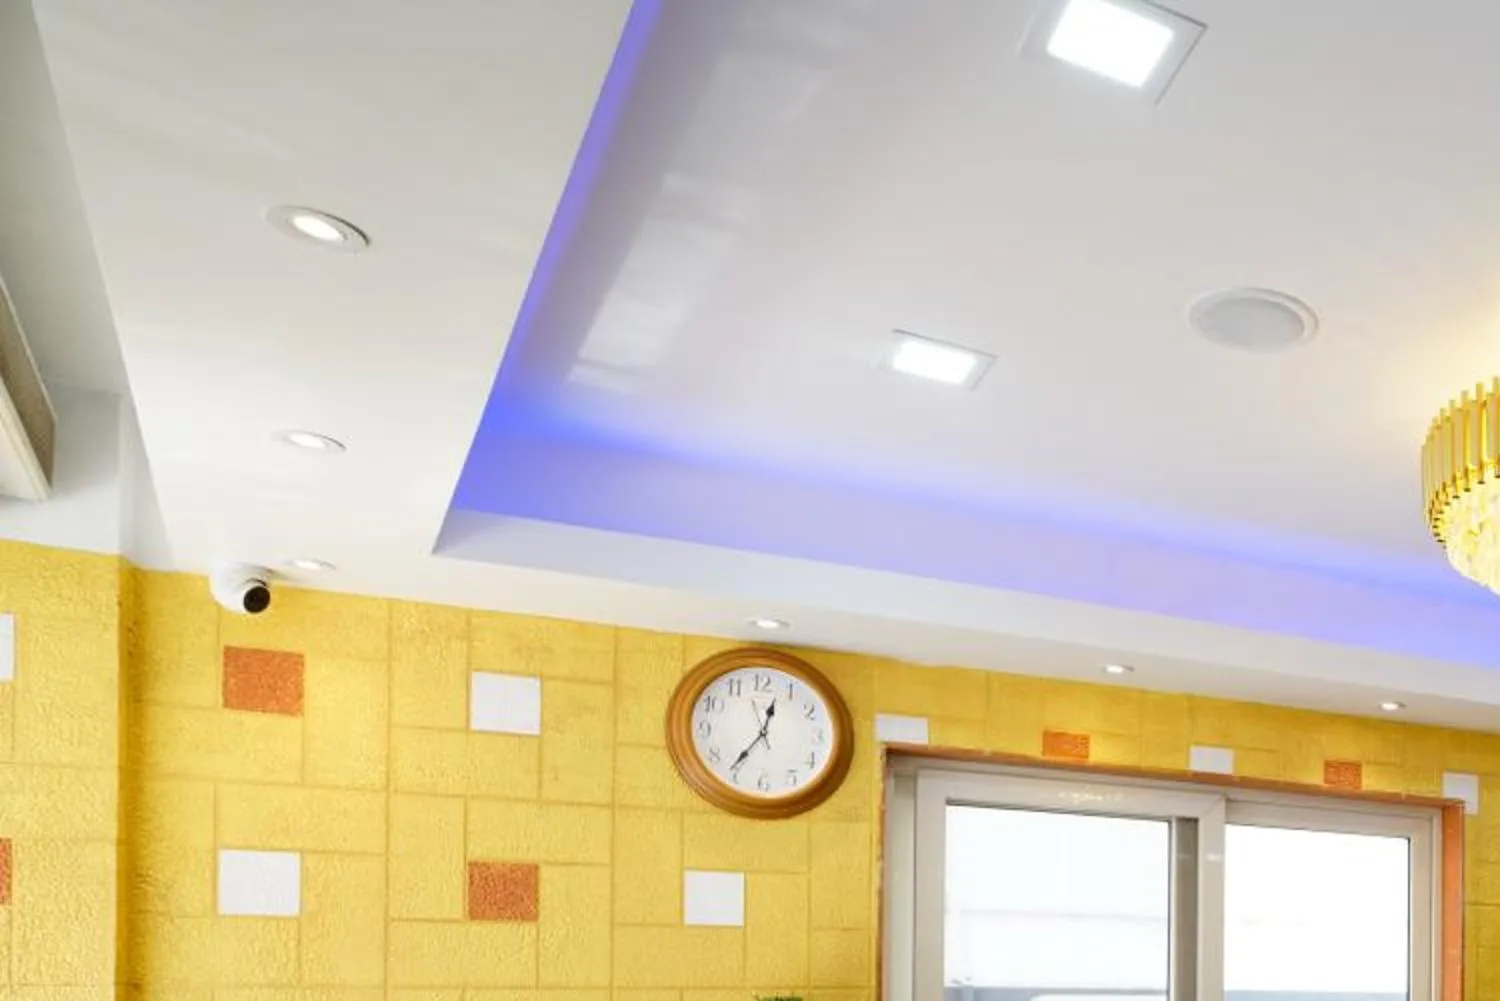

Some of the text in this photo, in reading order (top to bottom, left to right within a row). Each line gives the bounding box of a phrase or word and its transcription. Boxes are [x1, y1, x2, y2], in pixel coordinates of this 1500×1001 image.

[727, 677, 741, 697] 11
[754, 673, 773, 693] 12
[786, 682, 794, 701] 1
[703, 695, 725, 715] 10
[802, 702, 816, 721] 2
[699, 719, 712, 739] 9
[708, 746, 721, 765] 8
[803, 751, 816, 770] 4
[757, 770, 771, 792] 6
[785, 769, 798, 786] 5
